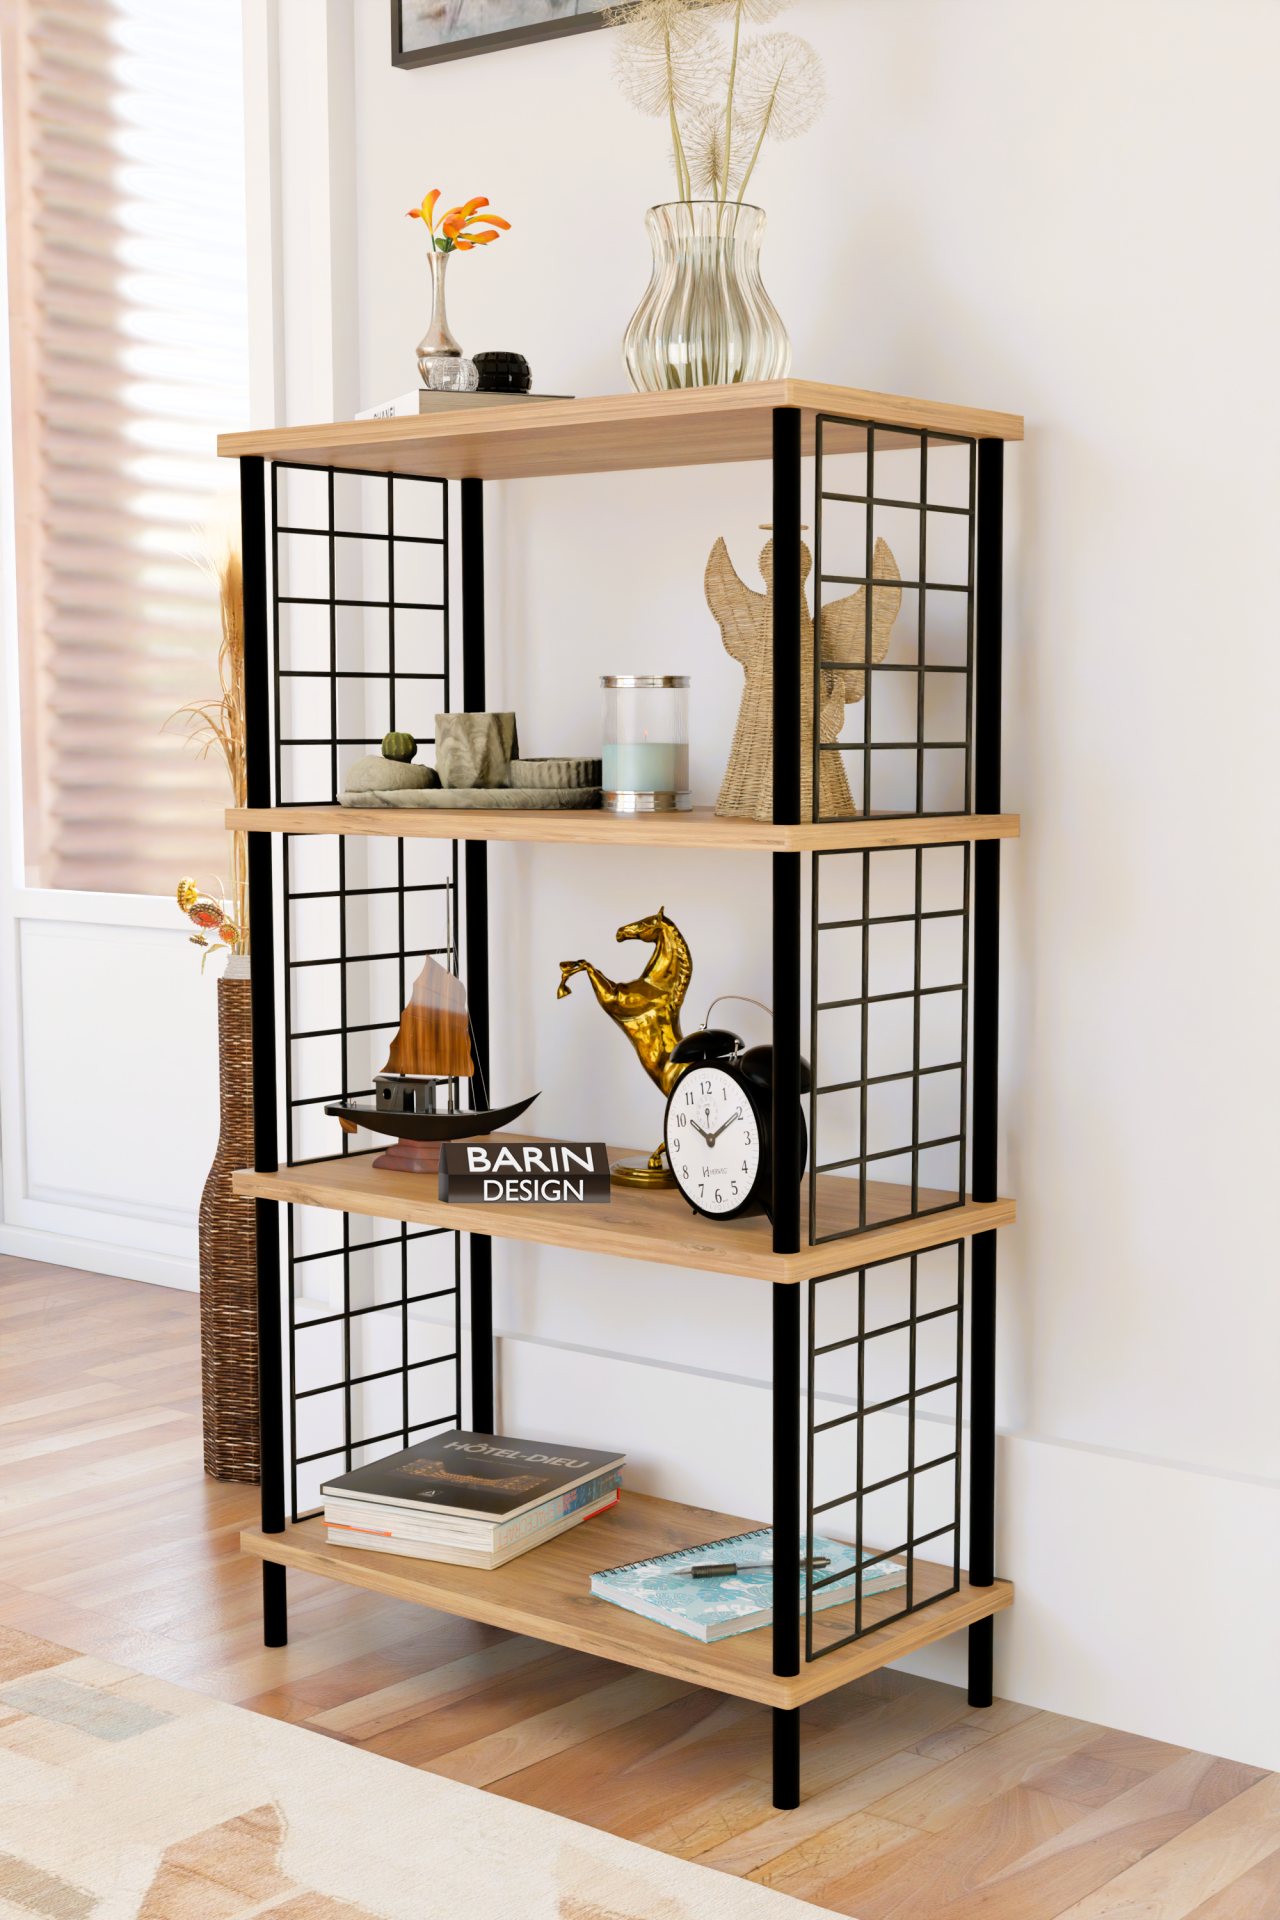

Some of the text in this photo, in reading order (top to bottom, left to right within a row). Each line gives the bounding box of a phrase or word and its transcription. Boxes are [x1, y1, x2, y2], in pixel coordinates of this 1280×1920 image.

[700, 1080, 712, 1095] 12
[722, 1087, 727, 1101] 1
[685, 1091, 694, 1105] 11
[676, 1113, 687, 1127] 10
[736, 1106, 743, 1120] 2
[743, 1130, 751, 1145] 3
[673, 1138, 680, 1153] 9
[466, 1146, 595, 1173] BARIN
[741, 1160, 749, 1174] 4
[682, 1165, 689, 1179] 8
[483, 1179, 584, 1202] DESIGN
[698, 1183, 704, 1198] 7
[714, 1188, 722, 1203] 6
[731, 1180, 738, 1196] 5
[443, 1441, 590, 1469] HÔTEL-DIEU
[497, 1501, 556, 1550] SPACECRAFT
